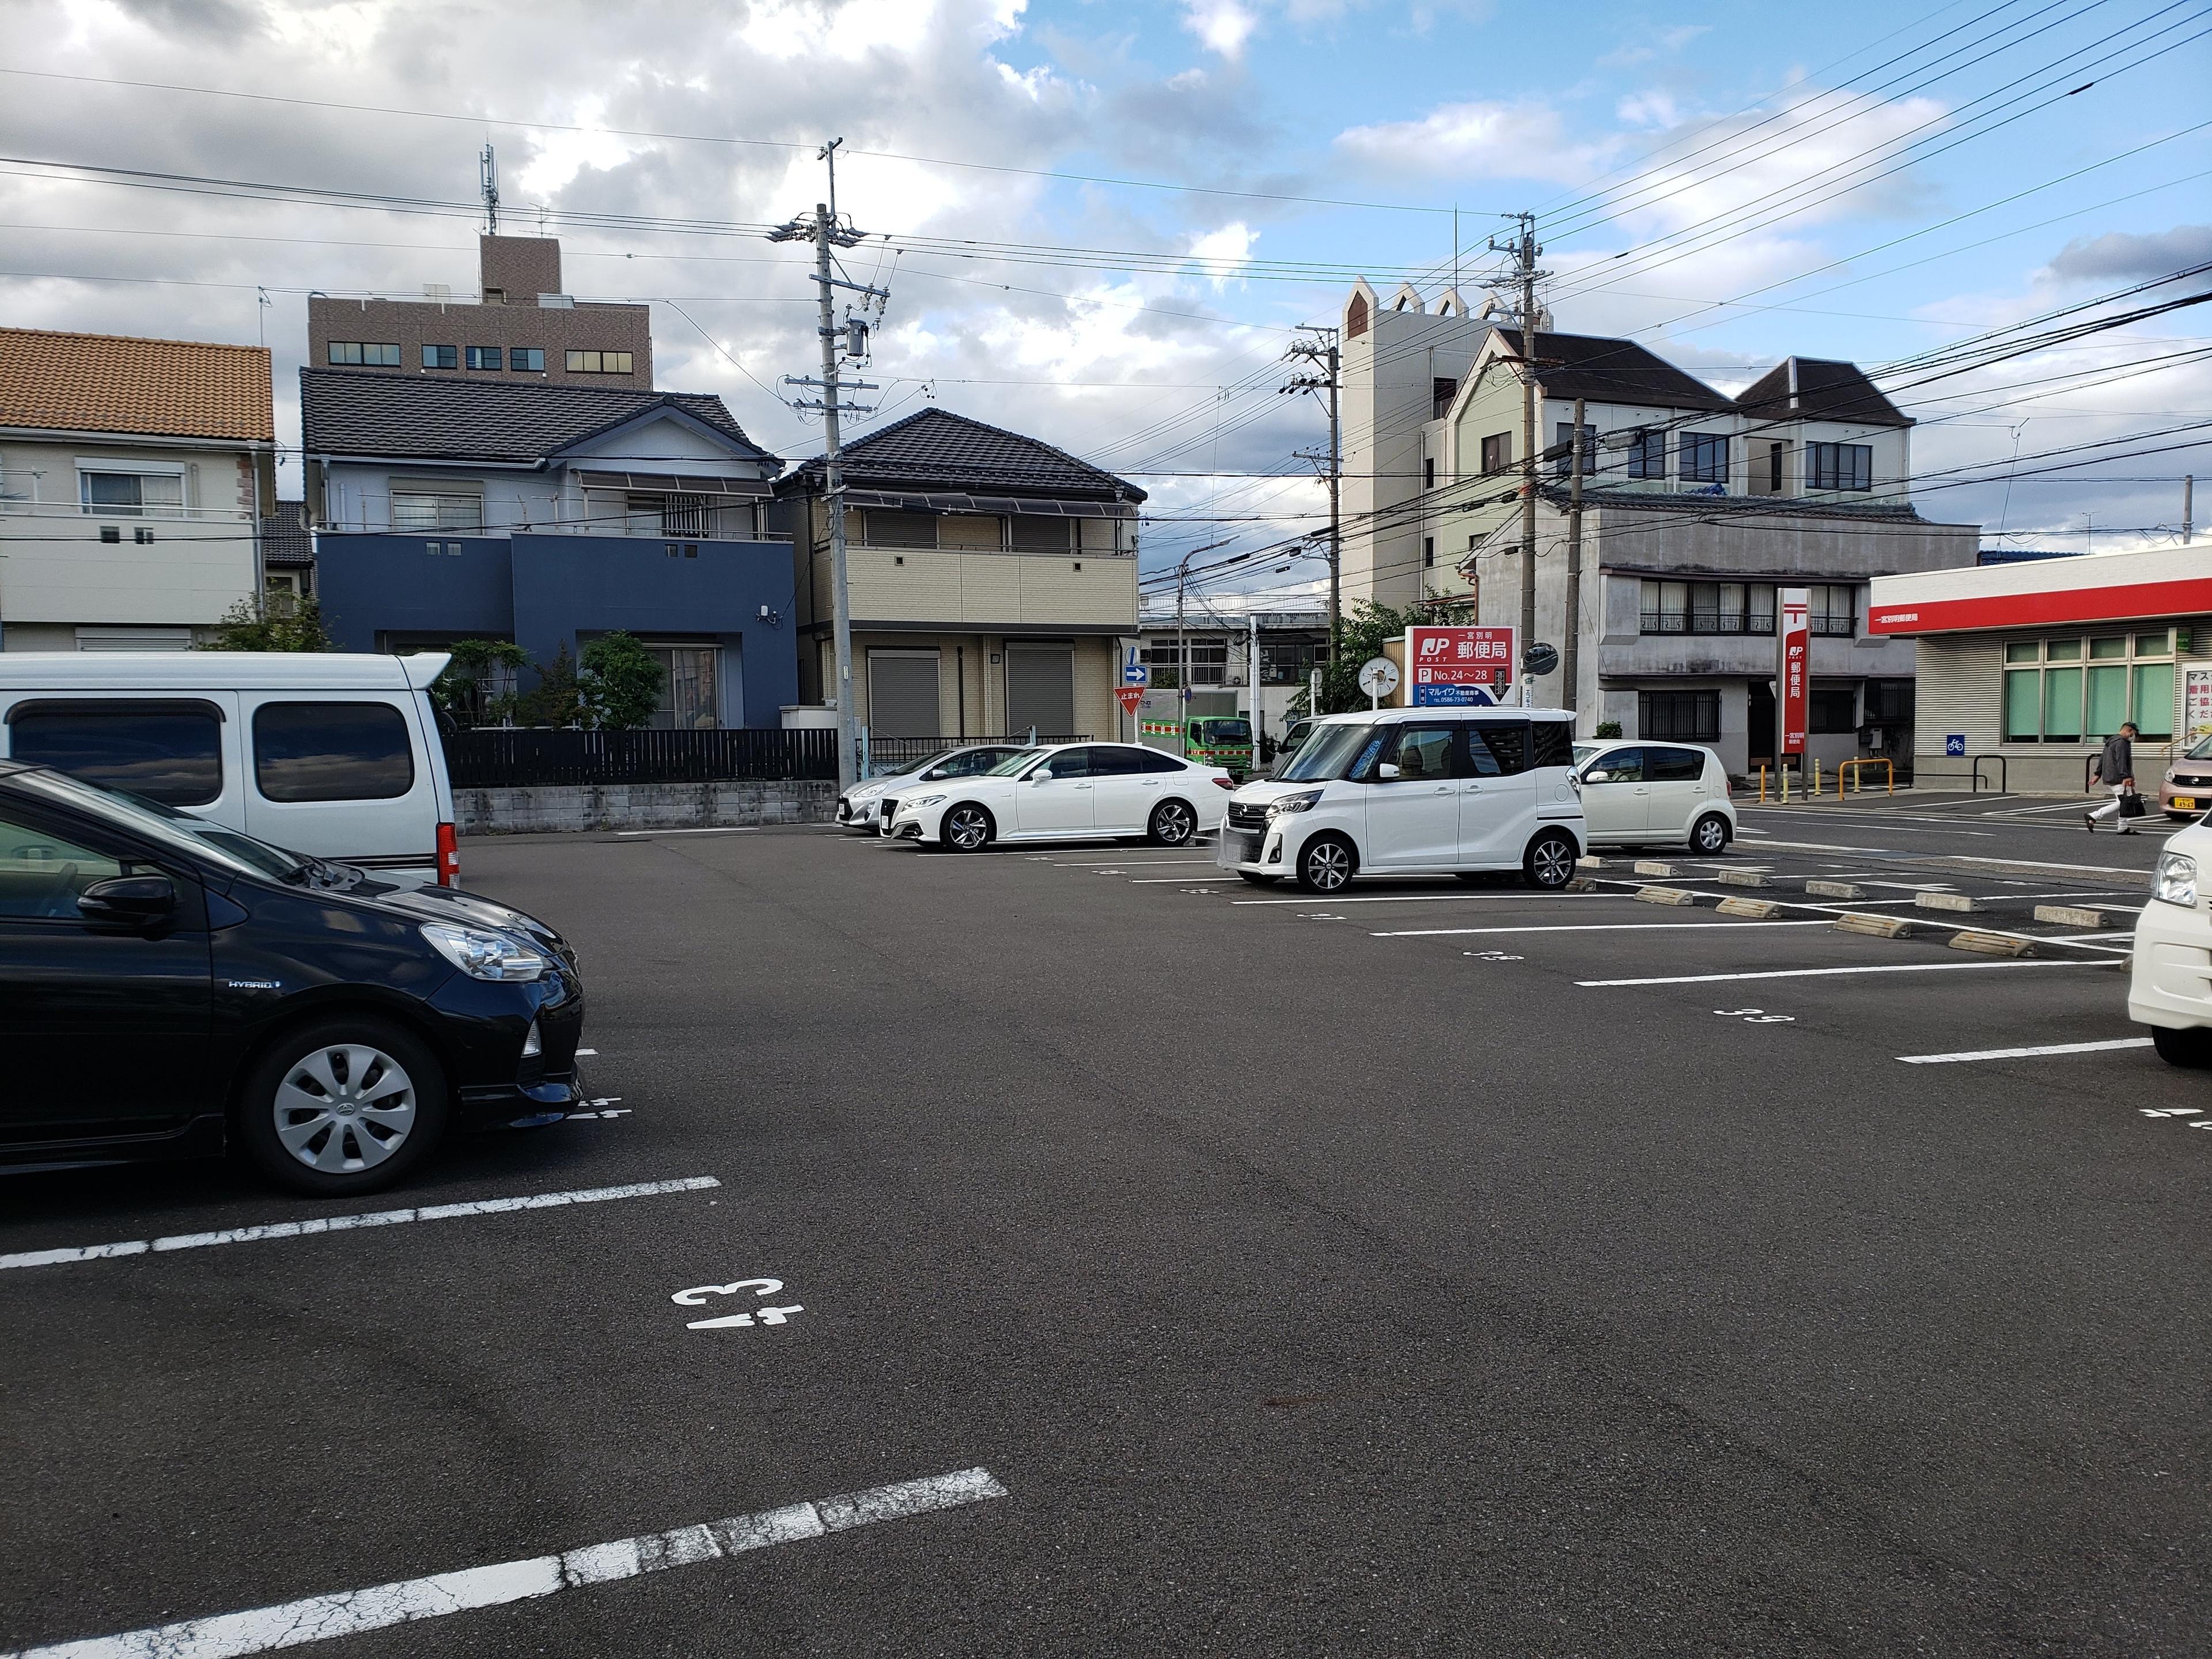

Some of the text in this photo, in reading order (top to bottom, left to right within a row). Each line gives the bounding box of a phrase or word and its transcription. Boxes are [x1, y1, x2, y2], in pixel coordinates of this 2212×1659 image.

[1457, 631, 1493, 639] 一宮別明
[1457, 641, 1507, 659] 郵便局
[1790, 662, 1801, 698] 郵便局
[2189, 672, 2212, 680] マス
[2189, 684, 2212, 694] 着用
[1121, 692, 1140, 700] 止まれ
[2189, 697, 2212, 706] ご協
[2189, 710, 2212, 718] くだ
[1713, 1009, 1795, 1022] 39
[671, 1277, 805, 1330] 43
